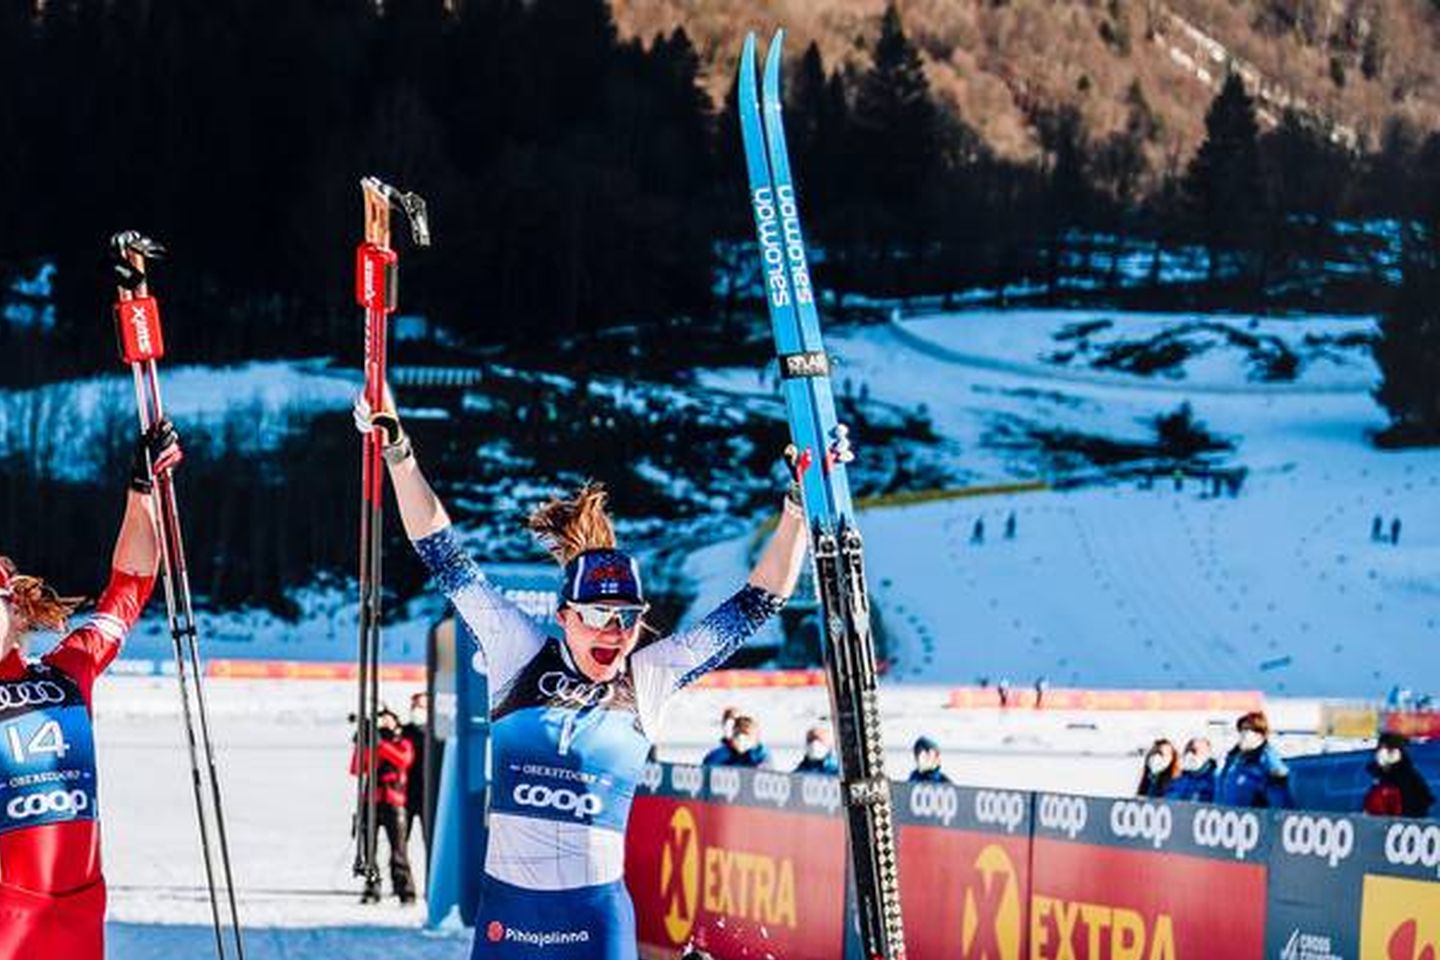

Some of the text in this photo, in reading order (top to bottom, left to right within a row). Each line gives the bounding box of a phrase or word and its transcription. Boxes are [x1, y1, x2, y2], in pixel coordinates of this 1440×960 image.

[752, 186, 789, 308] salomon
[777, 184, 814, 304] salomon
[7, 720, 70, 764] 14
[7, 789, 88, 819] coop
[513, 783, 603, 819] coop
[753, 772, 791, 807] coop
[910, 785, 958, 822] coop
[975, 791, 1024, 831] coop
[1039, 795, 1087, 838] coop
[1111, 801, 1172, 847] coop
[1193, 808, 1259, 858] coop
[1283, 815, 1354, 866] coop
[1385, 822, 1440, 877] coo
[704, 848, 797, 930] EXTRA
[505, 928, 590, 947] Pihlajalinna
